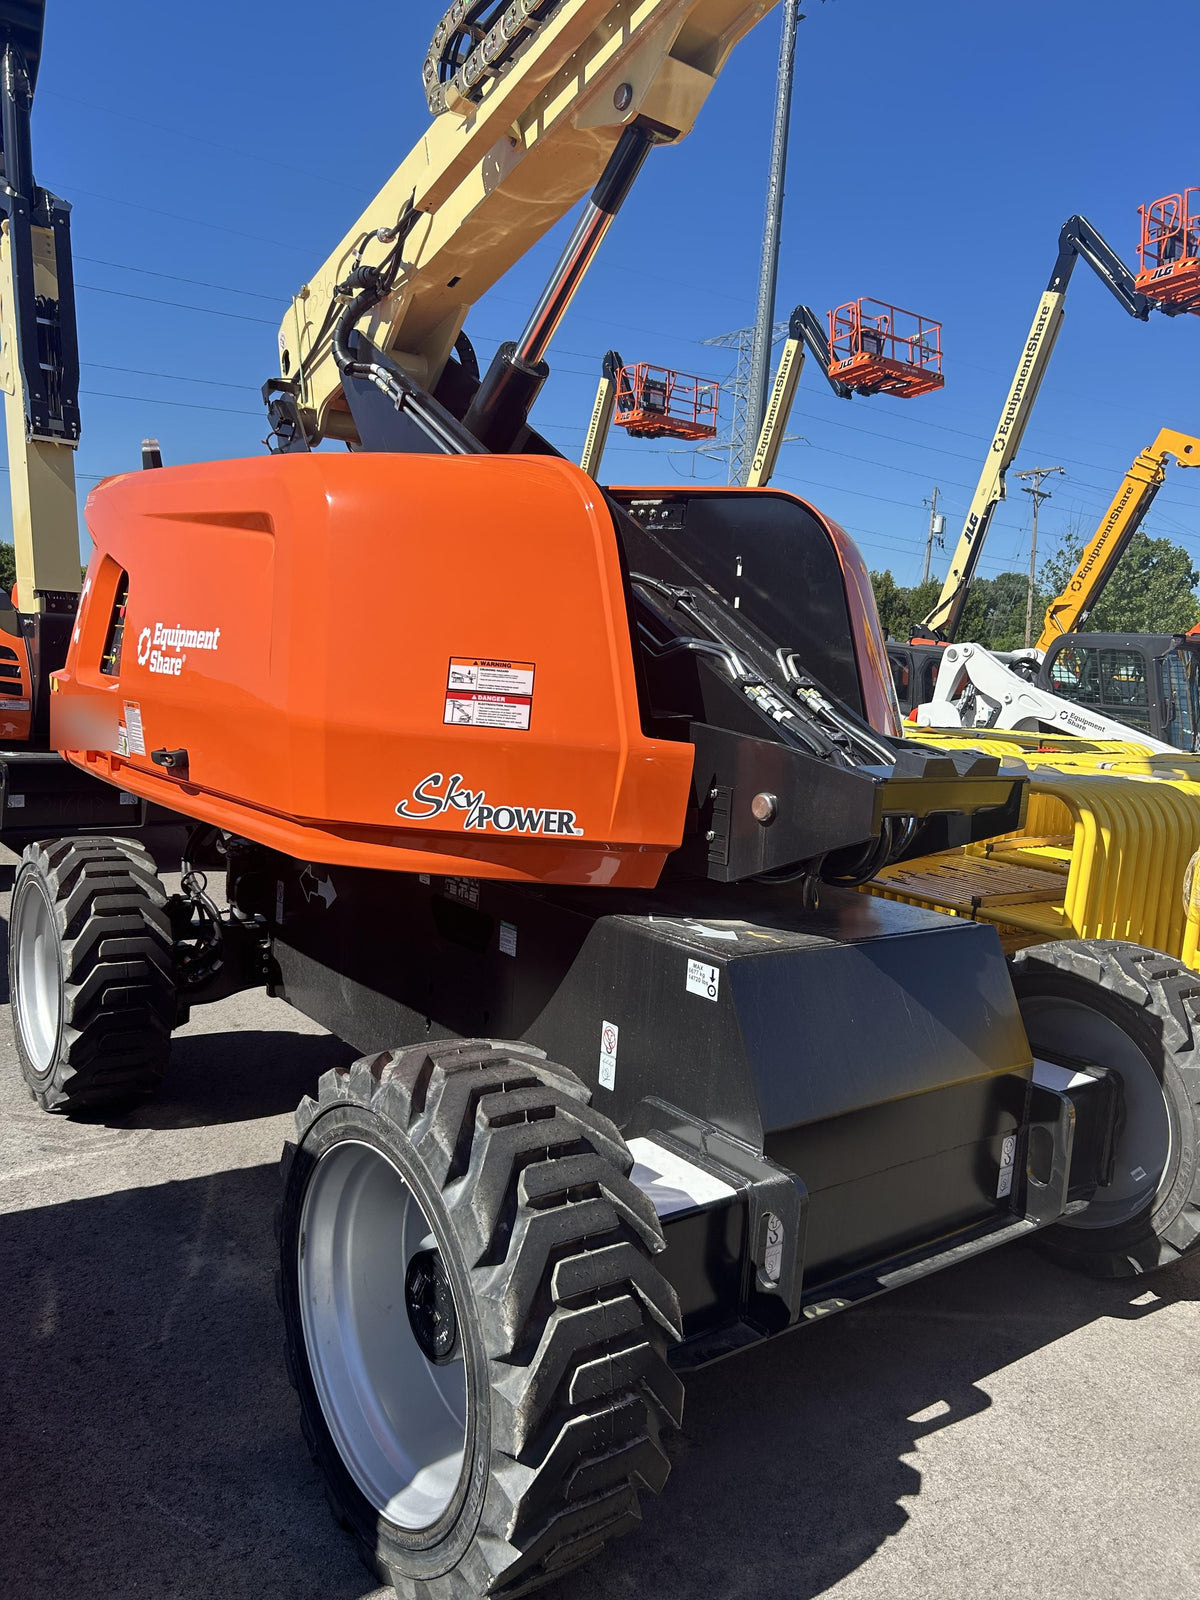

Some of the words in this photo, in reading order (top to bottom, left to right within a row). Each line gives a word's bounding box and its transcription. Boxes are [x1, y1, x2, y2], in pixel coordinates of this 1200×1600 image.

[1150, 265, 1174, 280] JLG
[839, 358, 854, 370] JLG
[998, 305, 1050, 436] EquipmentShare
[757, 349, 793, 457] EquipmentShare
[620, 413, 631, 421] JLG
[964, 512, 979, 545] JLG
[1077, 486, 1134, 580] EquipmentShare
[152, 622, 221, 653] Equipment
[149, 649, 183, 676] Share
[480, 660, 512, 668] WARNING
[1067, 719, 1087, 731] Share
[1069, 712, 1106, 732] Equipment
[693, 962, 704, 971] MAX
